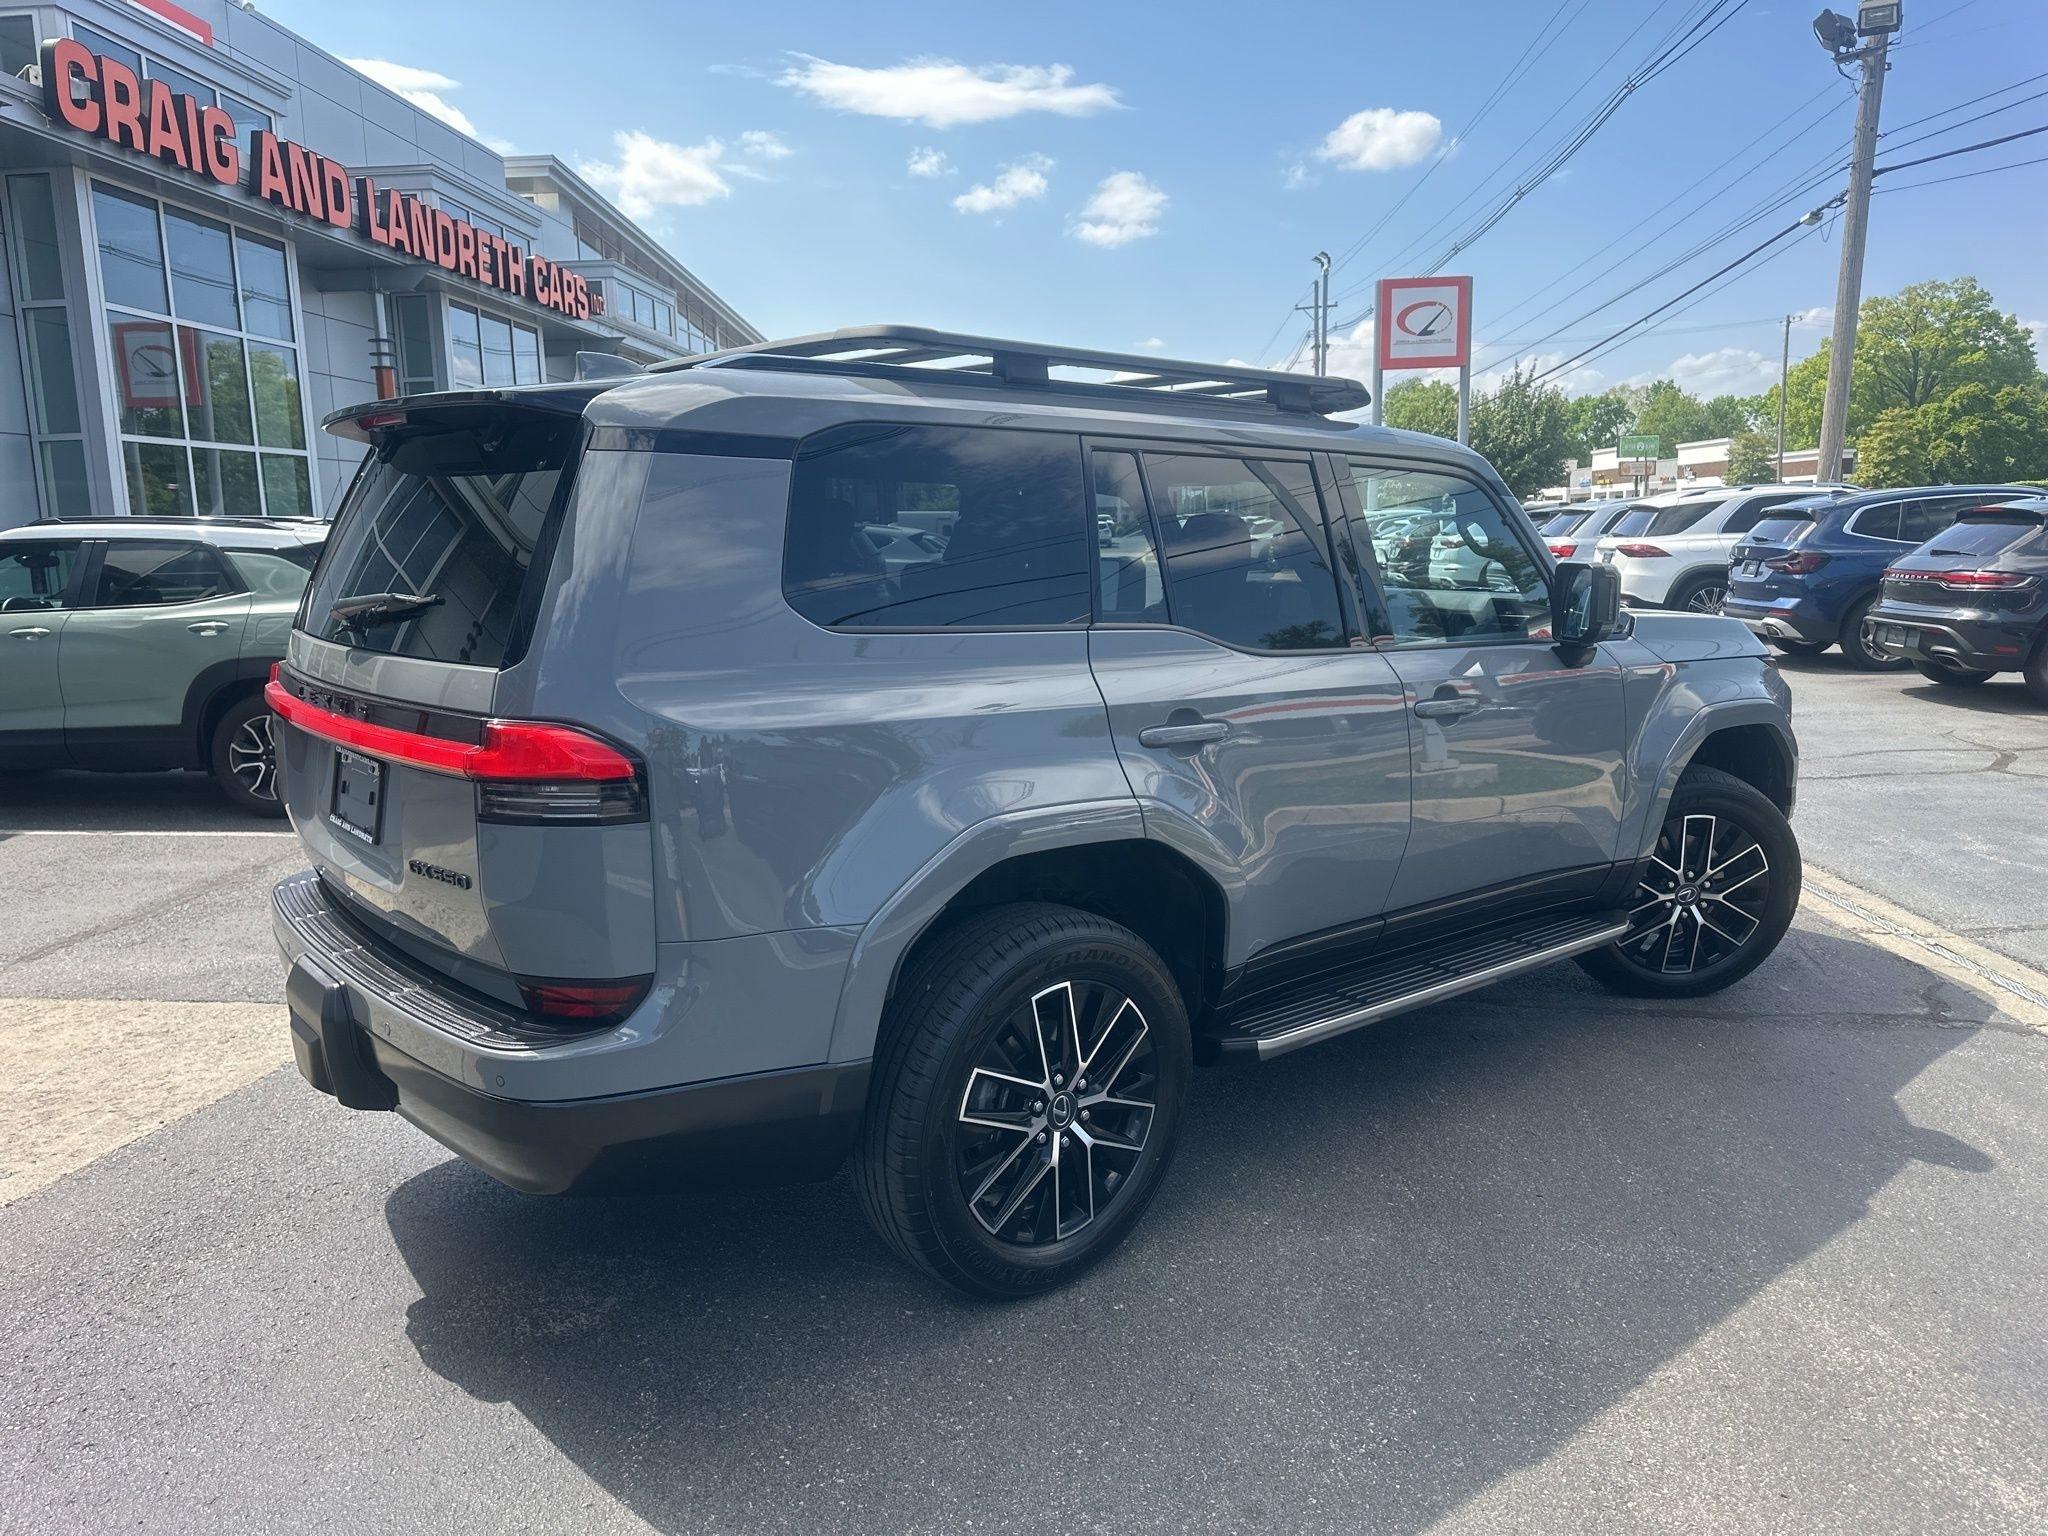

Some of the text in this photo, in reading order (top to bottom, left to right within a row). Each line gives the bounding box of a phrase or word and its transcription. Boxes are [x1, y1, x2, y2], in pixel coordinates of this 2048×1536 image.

[49, 37, 240, 186] CRAIG
[258, 129, 353, 230] AND
[363, 176, 527, 298] LANDRETH
[532, 253, 590, 321] CARS
